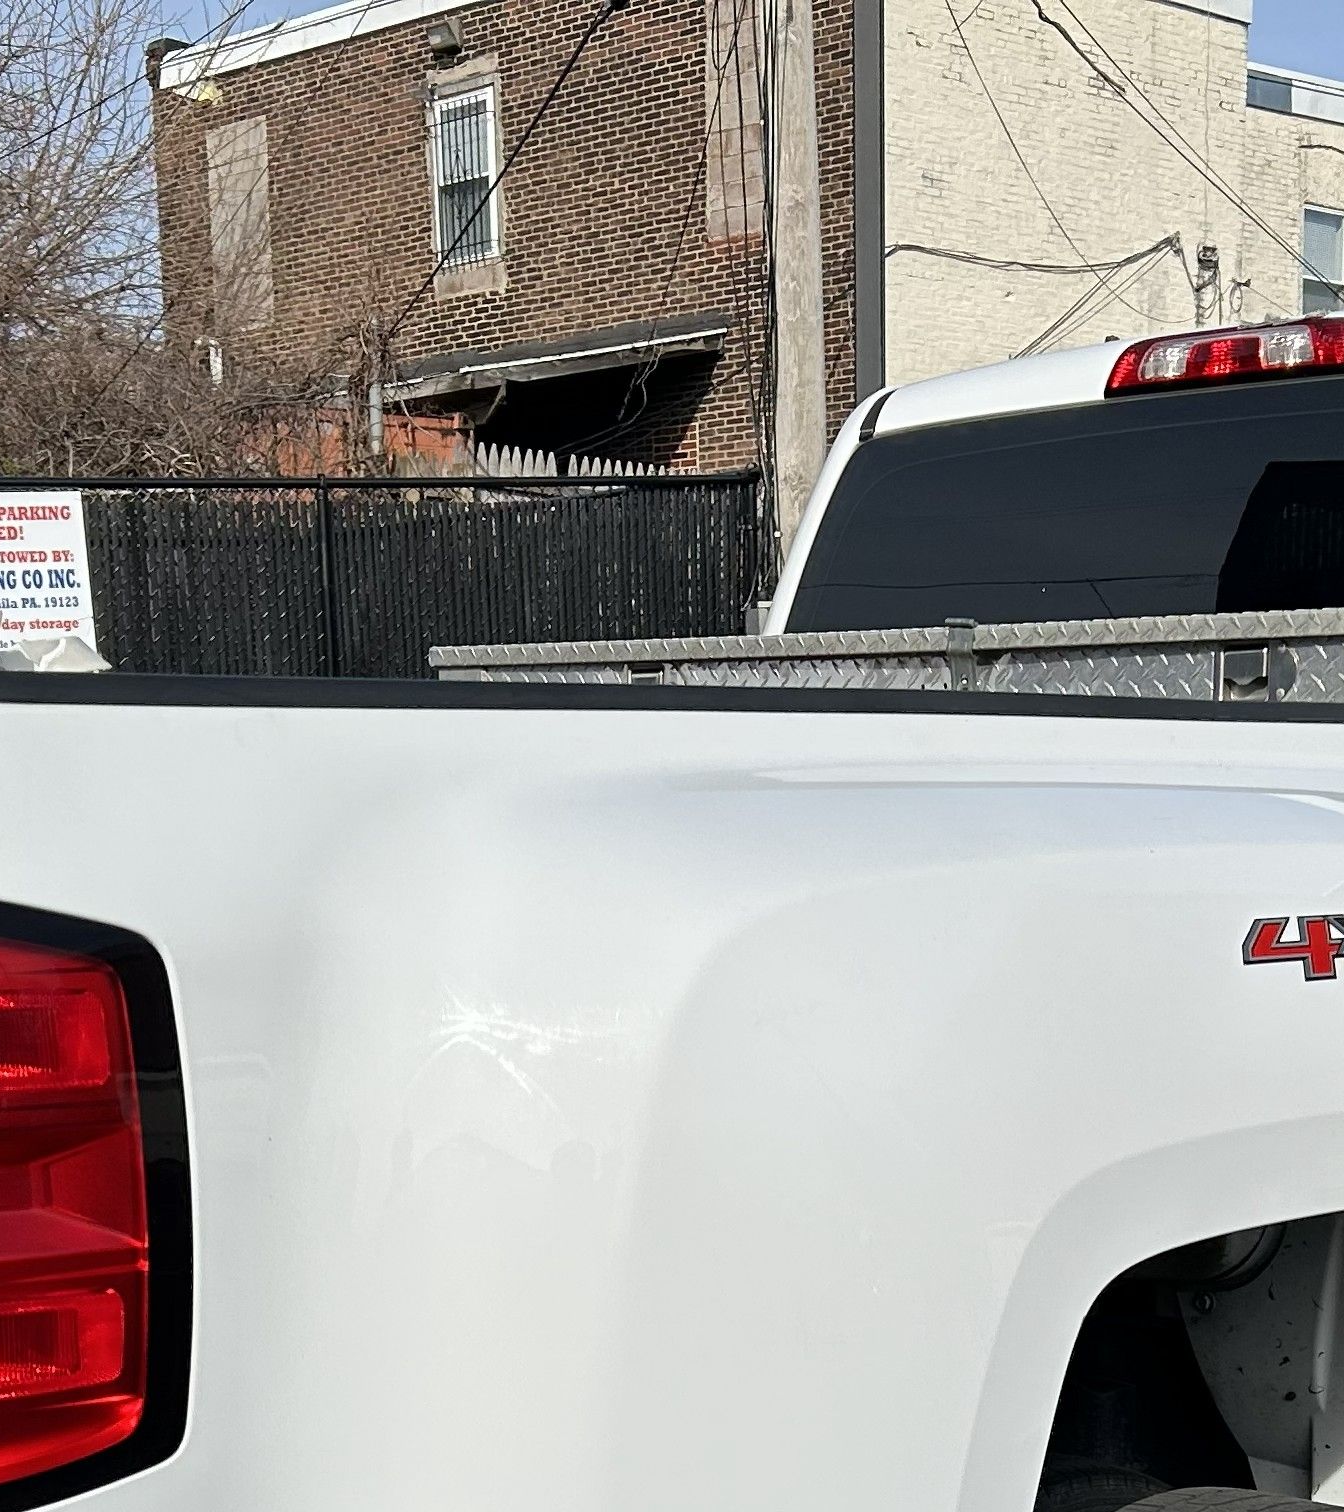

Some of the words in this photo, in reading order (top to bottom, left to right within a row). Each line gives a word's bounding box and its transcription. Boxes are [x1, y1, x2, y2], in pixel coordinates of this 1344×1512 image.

[52, 550, 75, 562] BY:
[22, 569, 43, 589] CO
[48, 569, 81, 589] INC.
[21, 598, 41, 609] PA.
[44, 596, 79, 608] 19123
[1, 620, 25, 632] day
[29, 618, 79, 632] storage
